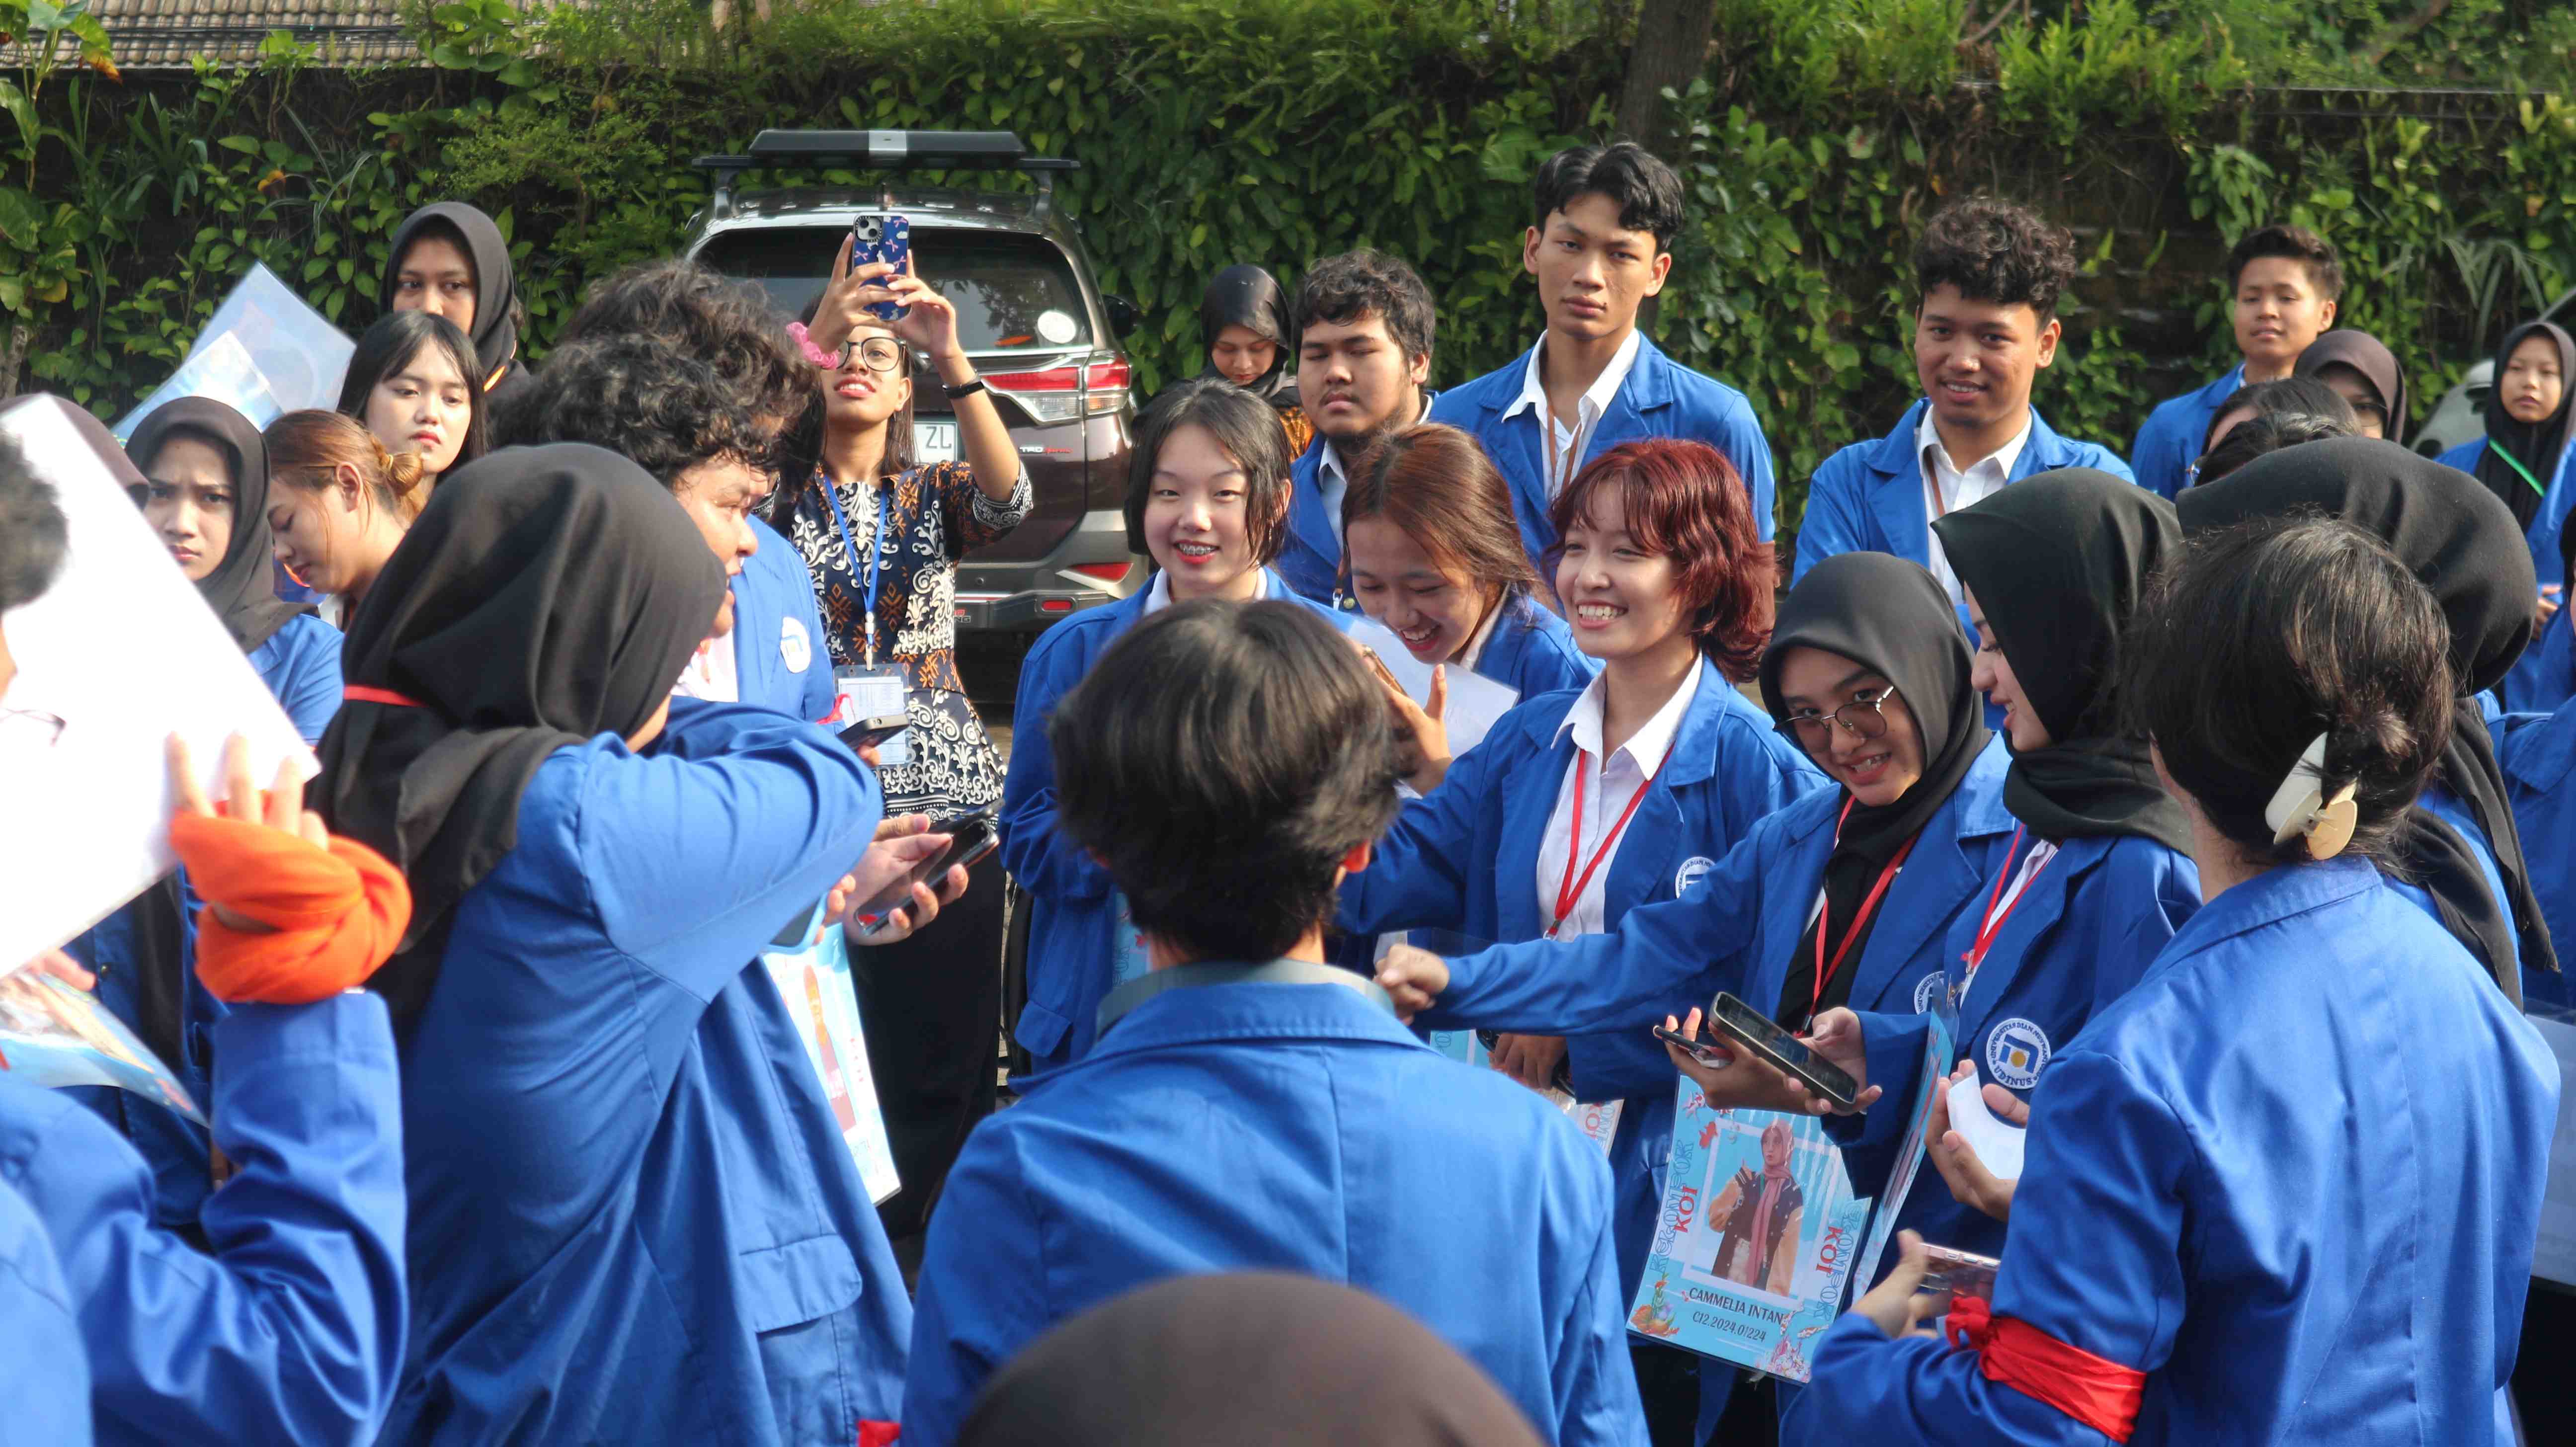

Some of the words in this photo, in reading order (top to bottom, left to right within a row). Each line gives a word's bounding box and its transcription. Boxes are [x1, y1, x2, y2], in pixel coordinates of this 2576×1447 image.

[925, 426, 952, 449] ZL
[2016, 1023, 2033, 1033] DIAN
[1994, 1065, 2032, 1086] UDINUS
[1673, 1186, 1698, 1233] KOI
[1816, 1225, 1844, 1276] KOI
[1689, 1287, 1746, 1314] CAMMELIA
[1748, 1303, 1784, 1326] INTAN
